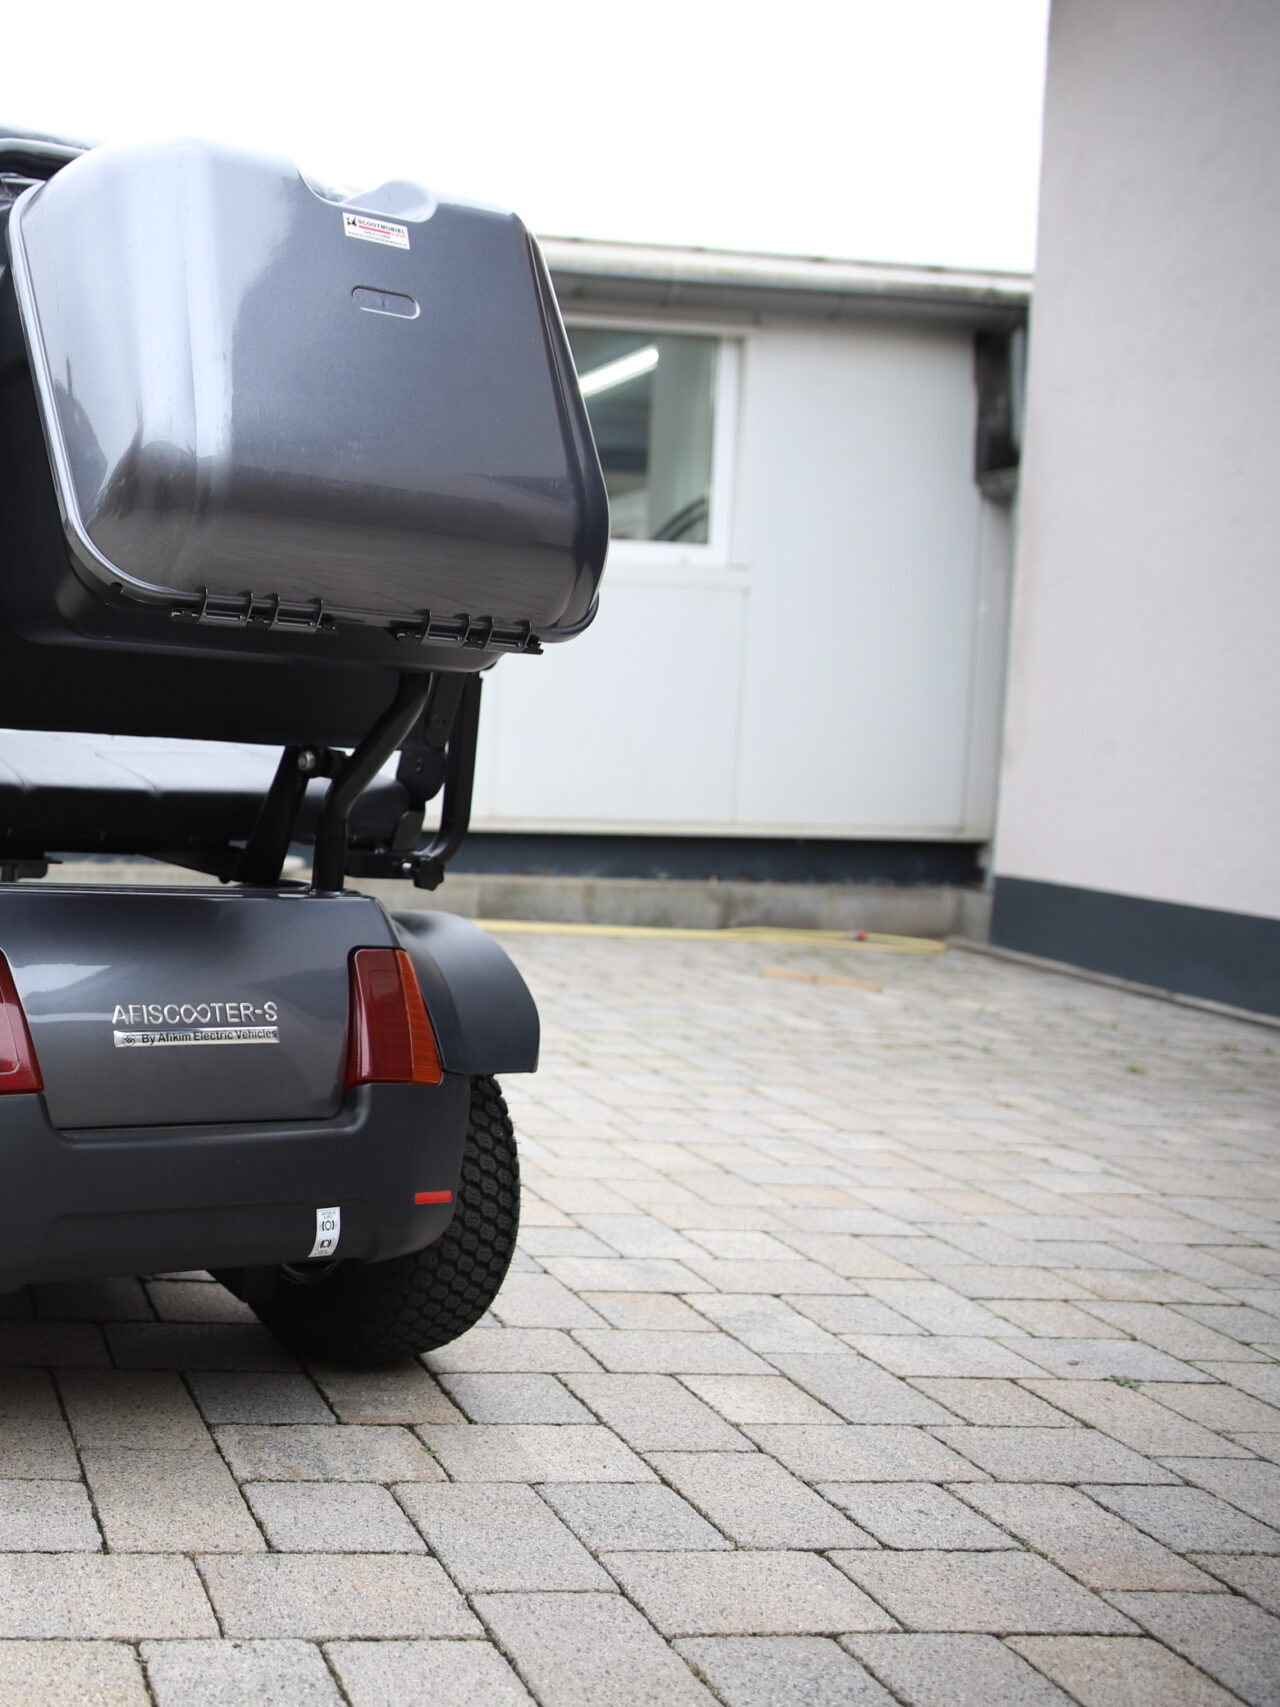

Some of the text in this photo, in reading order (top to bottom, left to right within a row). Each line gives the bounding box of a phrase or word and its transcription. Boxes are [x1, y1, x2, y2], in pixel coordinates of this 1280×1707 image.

[358, 219, 404, 234] SCOOTMOBIEL
[111, 1001, 278, 1025] AFISCOOTER-S
[141, 1029, 278, 1046] By Afikim Electric Vehicles
